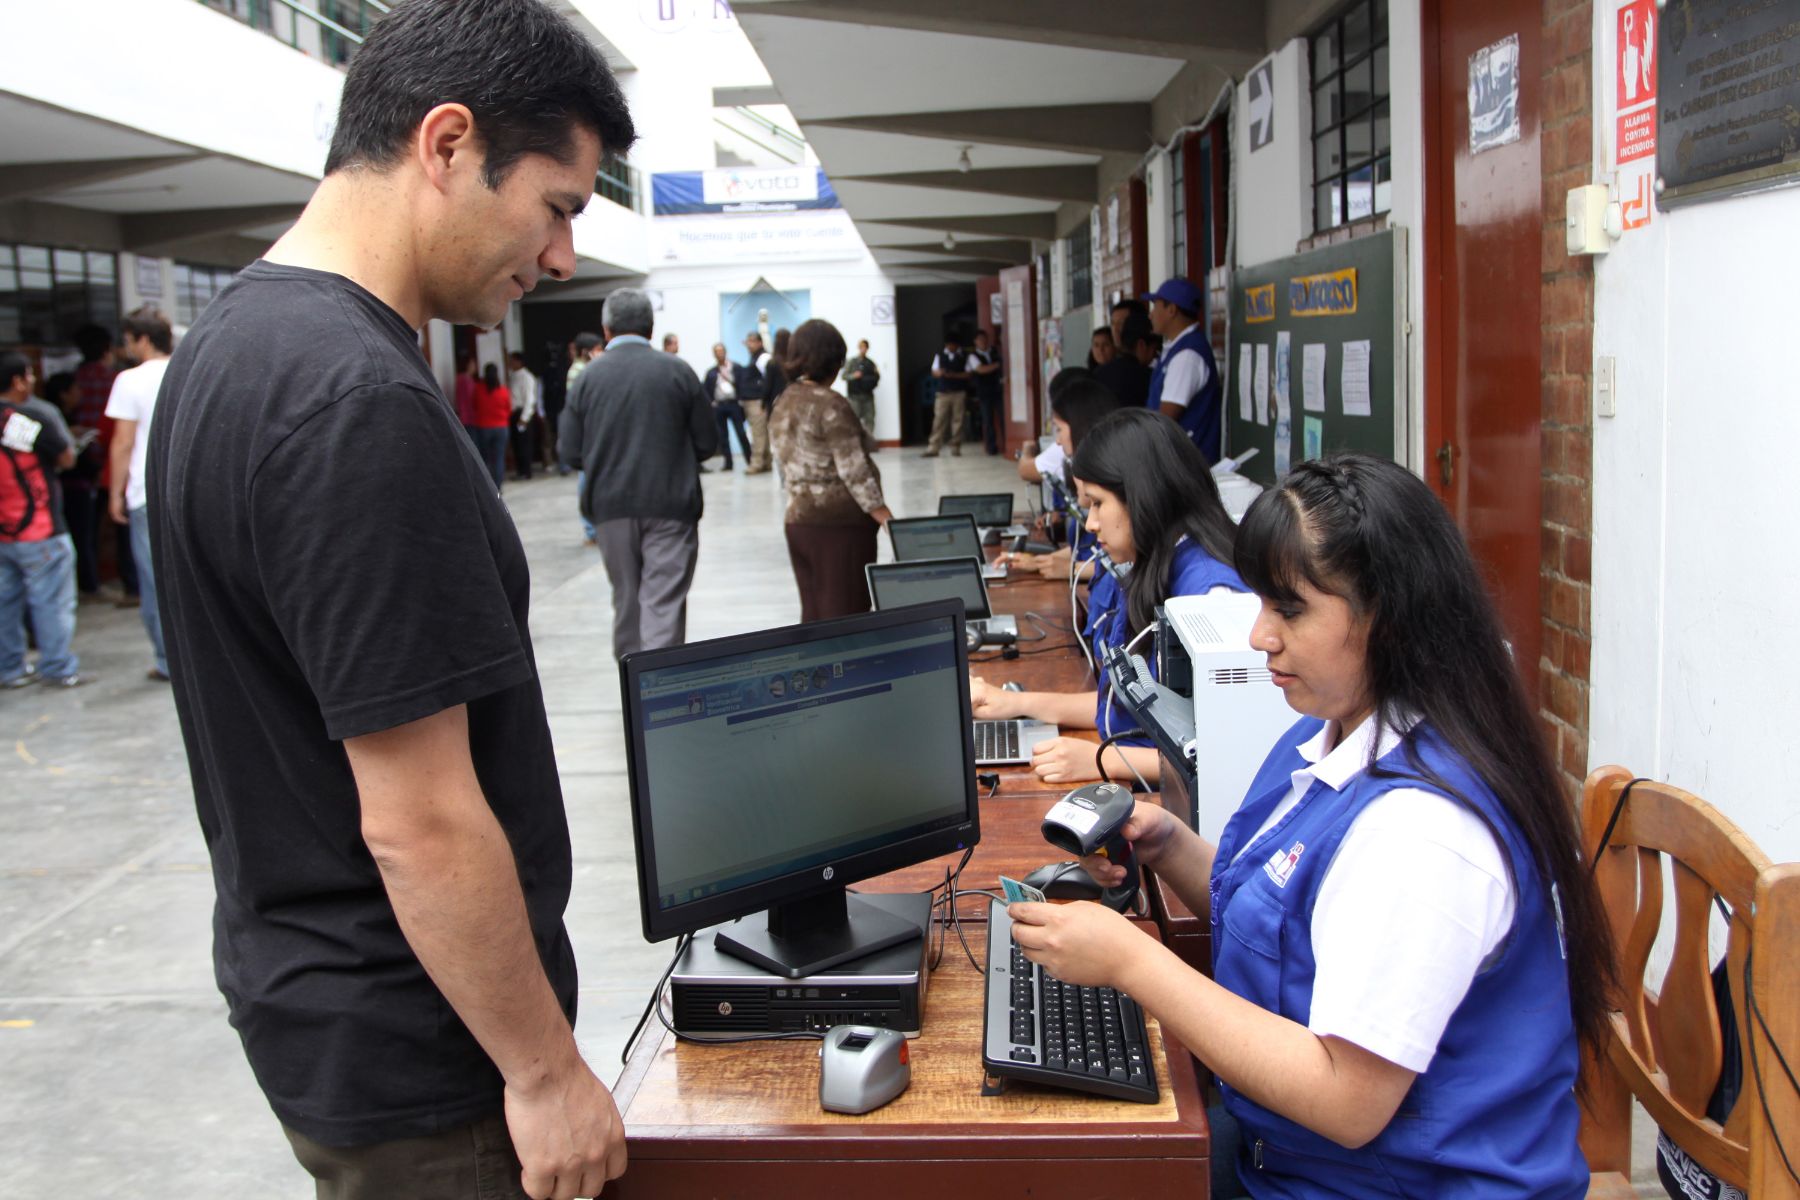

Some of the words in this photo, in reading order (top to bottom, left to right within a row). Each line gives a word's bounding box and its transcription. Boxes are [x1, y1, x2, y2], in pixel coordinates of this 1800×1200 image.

[1625, 112, 1651, 128] ALARMA
[1625, 126, 1650, 143] CONTRA
[1620, 138, 1655, 158] INCENDIOS
